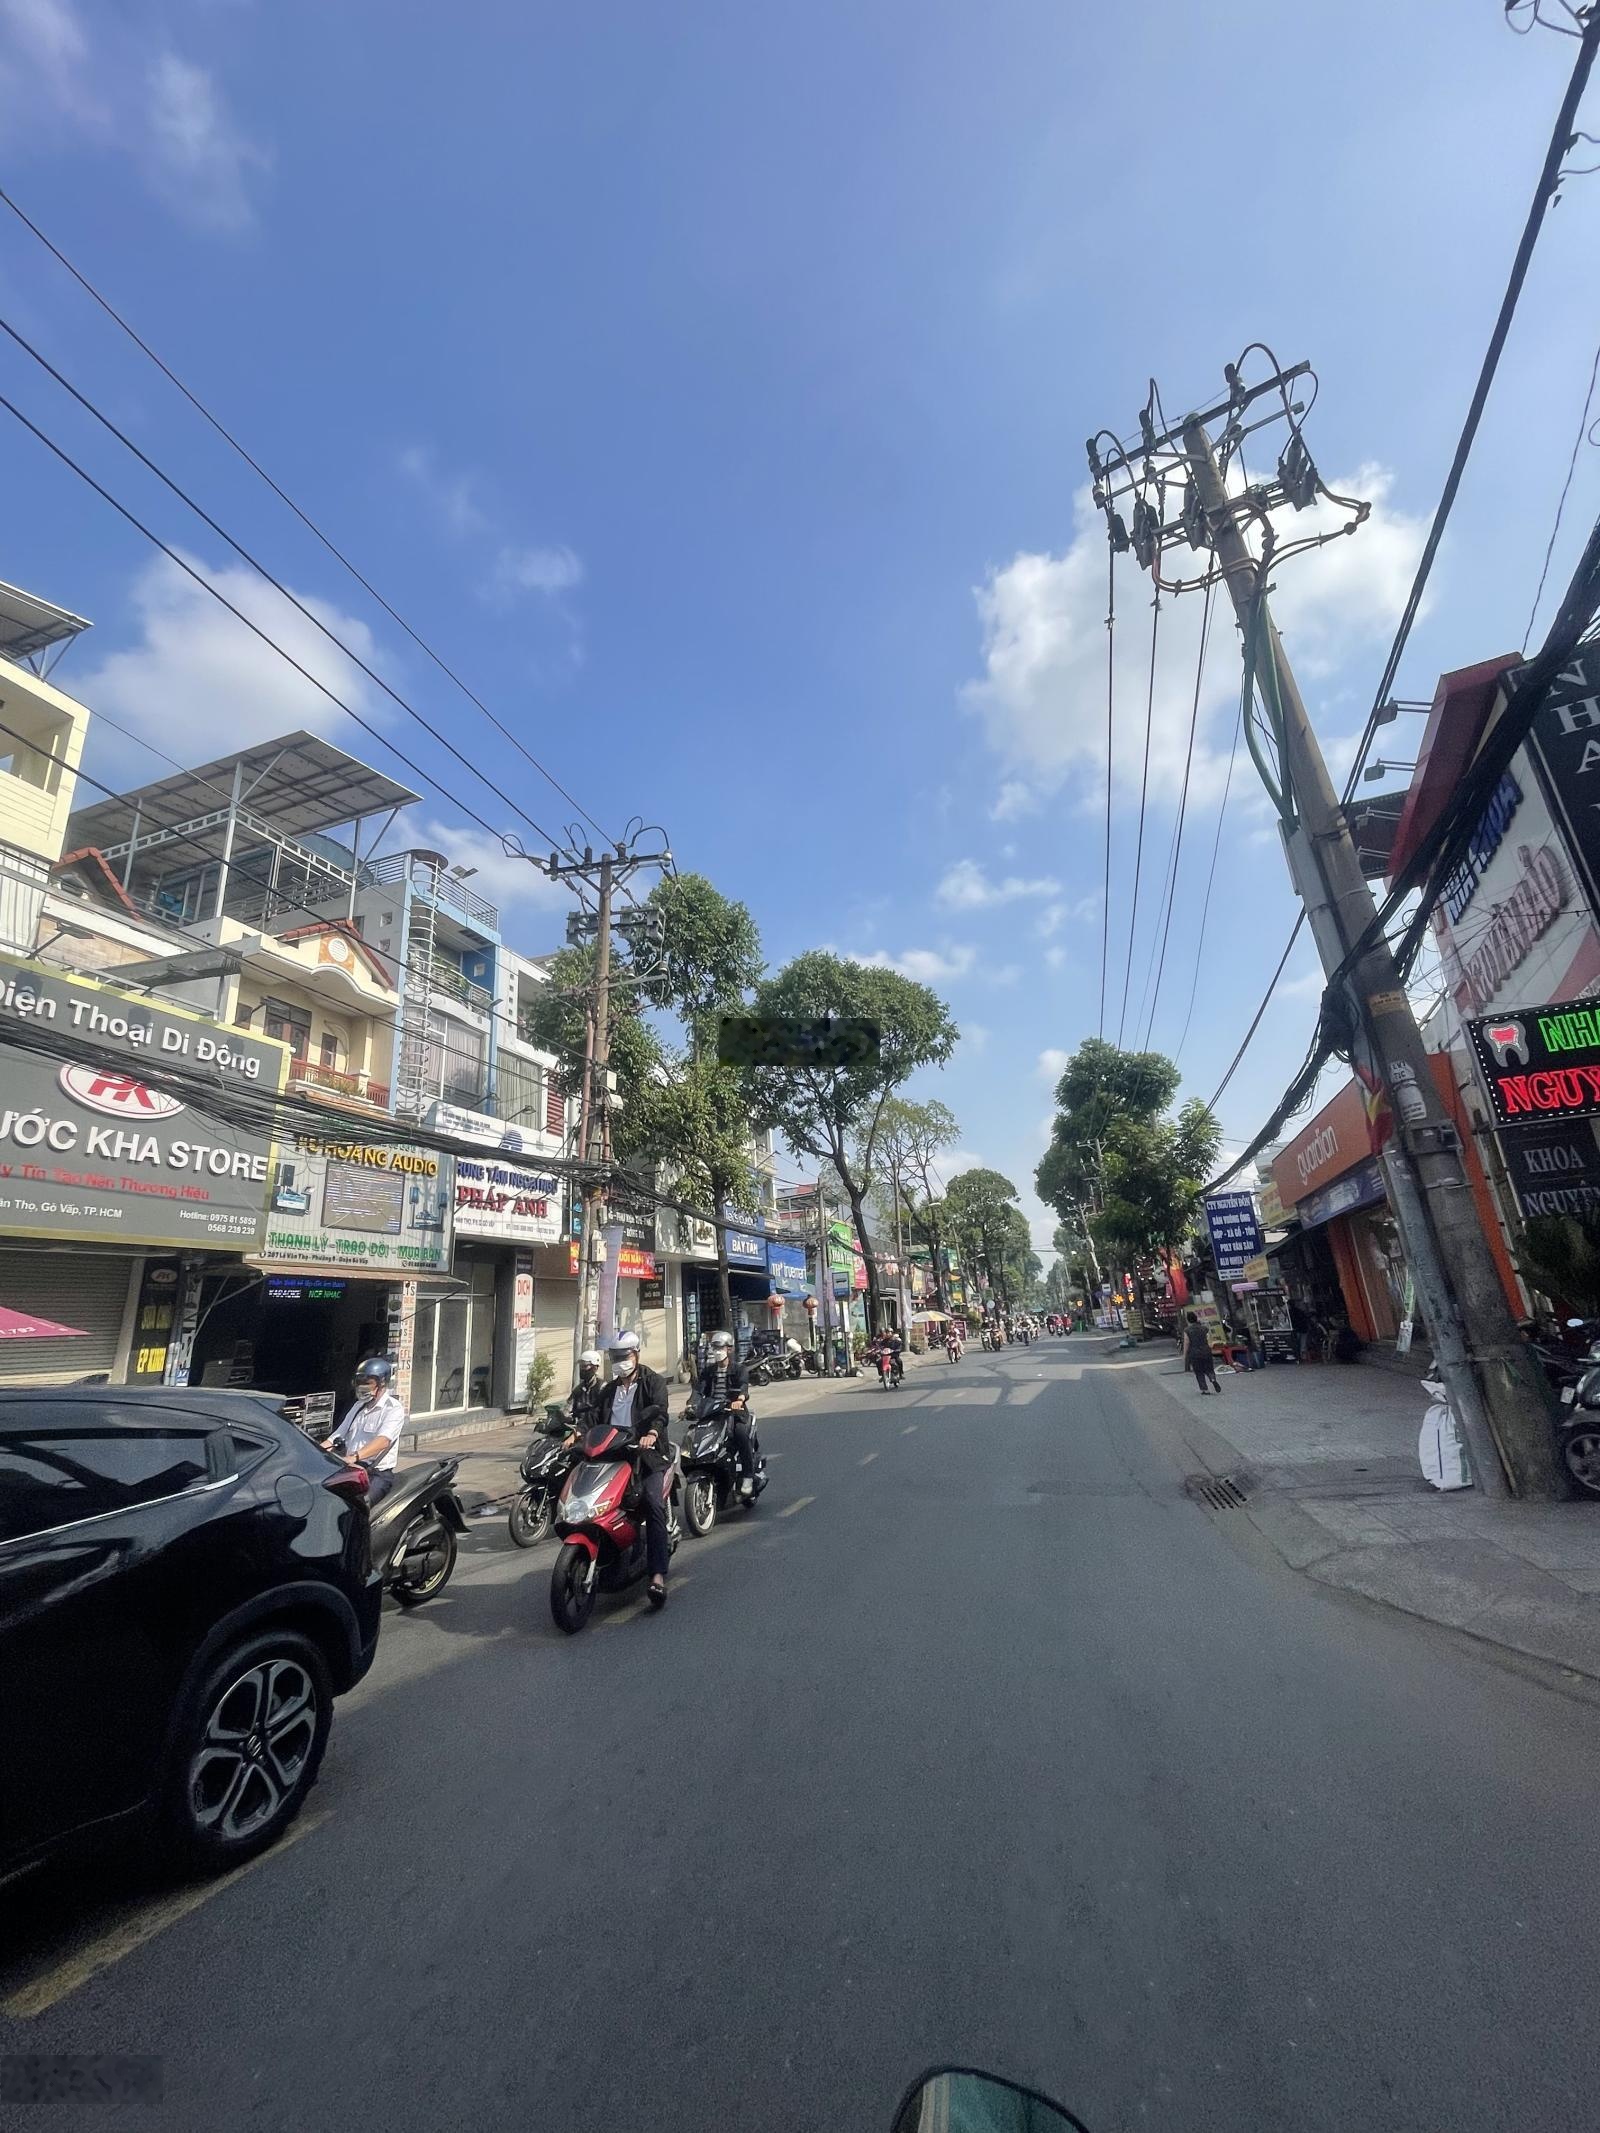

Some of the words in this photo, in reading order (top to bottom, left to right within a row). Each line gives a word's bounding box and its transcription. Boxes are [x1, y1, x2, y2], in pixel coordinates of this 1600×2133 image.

[0, 978, 56, 1019] iện
[69, 999, 154, 1048] Thoại
[162, 1027, 190, 1055] Di
[196, 1038, 261, 1079] Động
[1538, 1008, 1600, 1053] NH
[86, 1126, 161, 1165] KHA
[168, 1140, 268, 1181] STORE
[391, 1152, 439, 1178] AUDIO
[1297, 1125, 1340, 1186] guardian
[1522, 1144, 1587, 1174] KHOA
[180, 1209, 210, 1222] Hotline:
[456, 1186, 509, 1214] PHÁP
[511, 1195, 549, 1219] ANH
